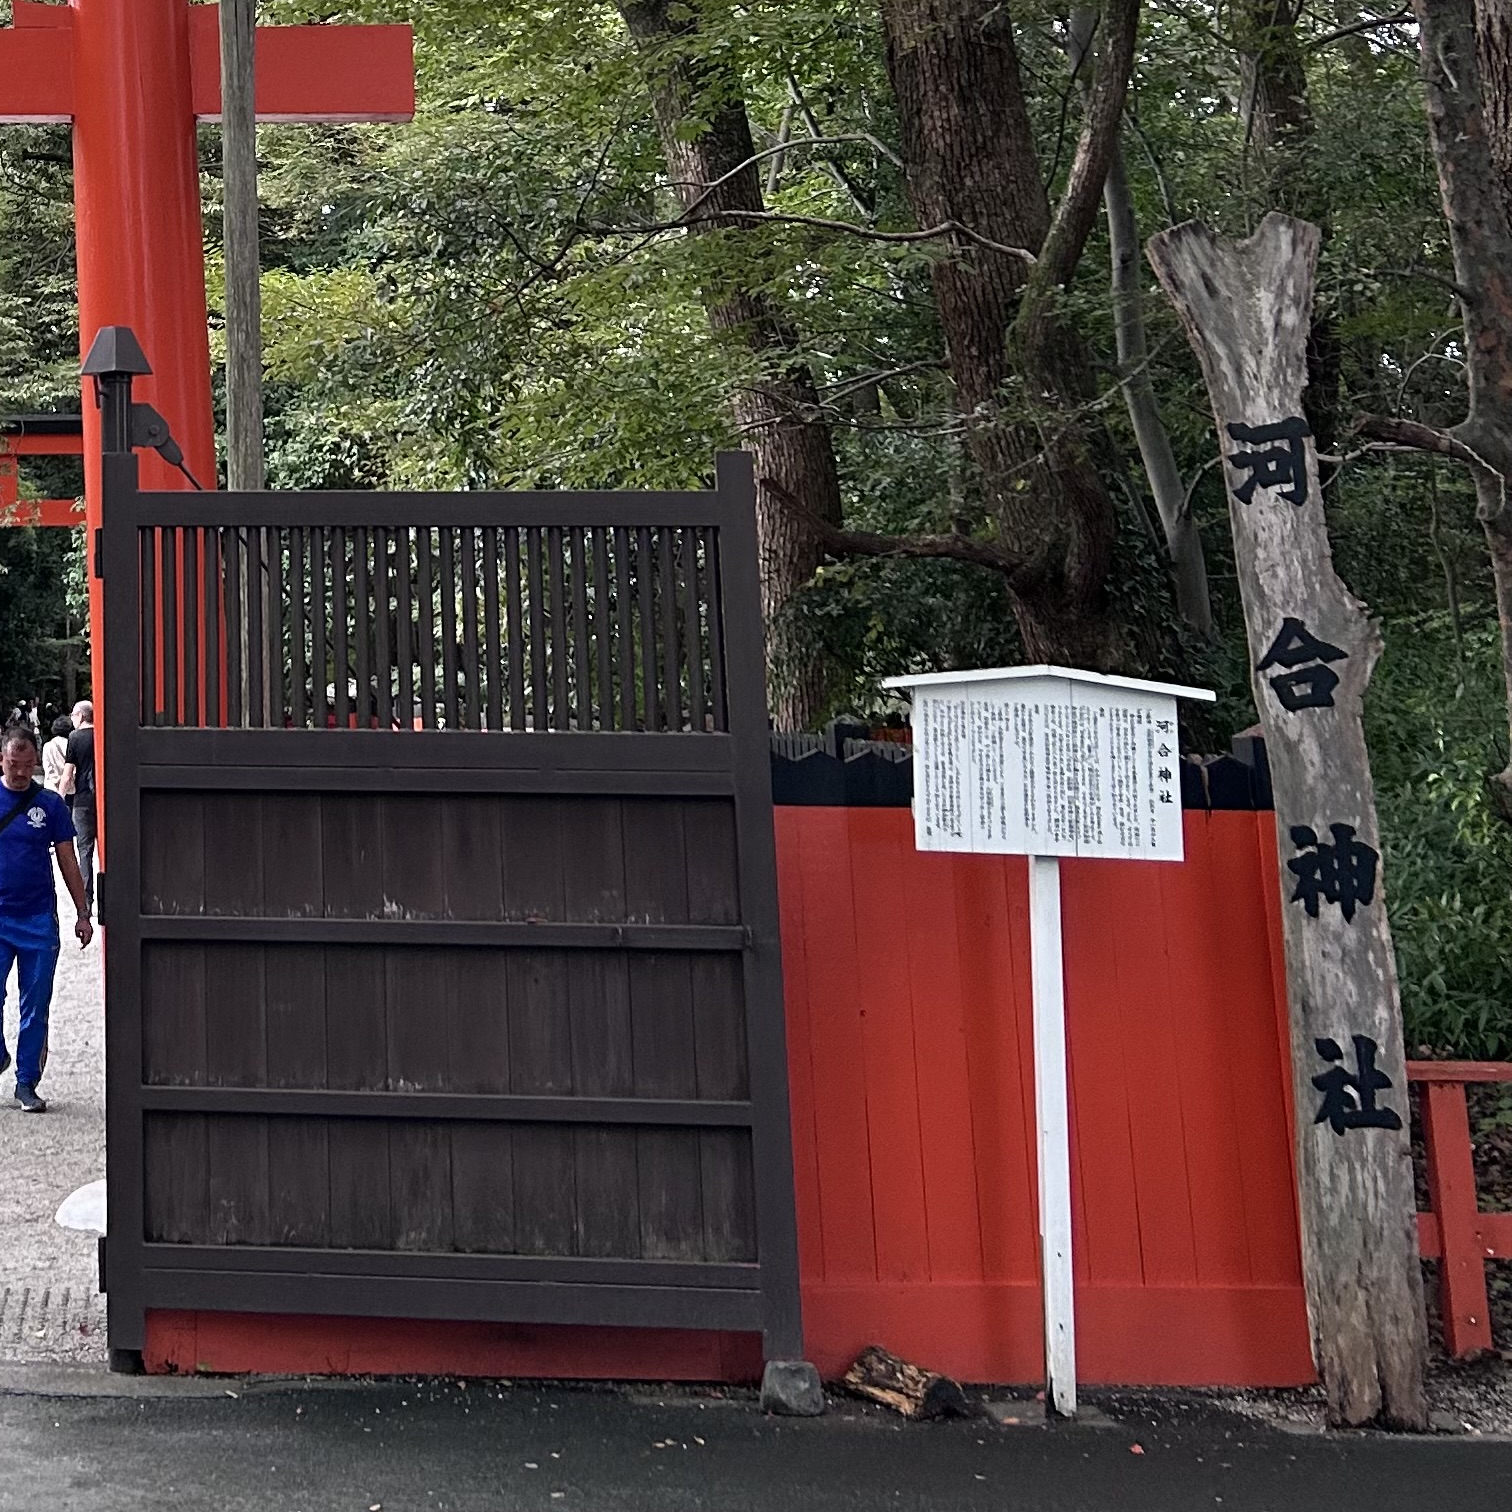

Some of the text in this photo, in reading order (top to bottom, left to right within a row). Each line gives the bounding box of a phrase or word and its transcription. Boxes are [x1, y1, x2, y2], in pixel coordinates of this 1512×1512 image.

[1156, 719, 1173, 804] 河合神社
[1227, 418, 1402, 1136] 河合神社
